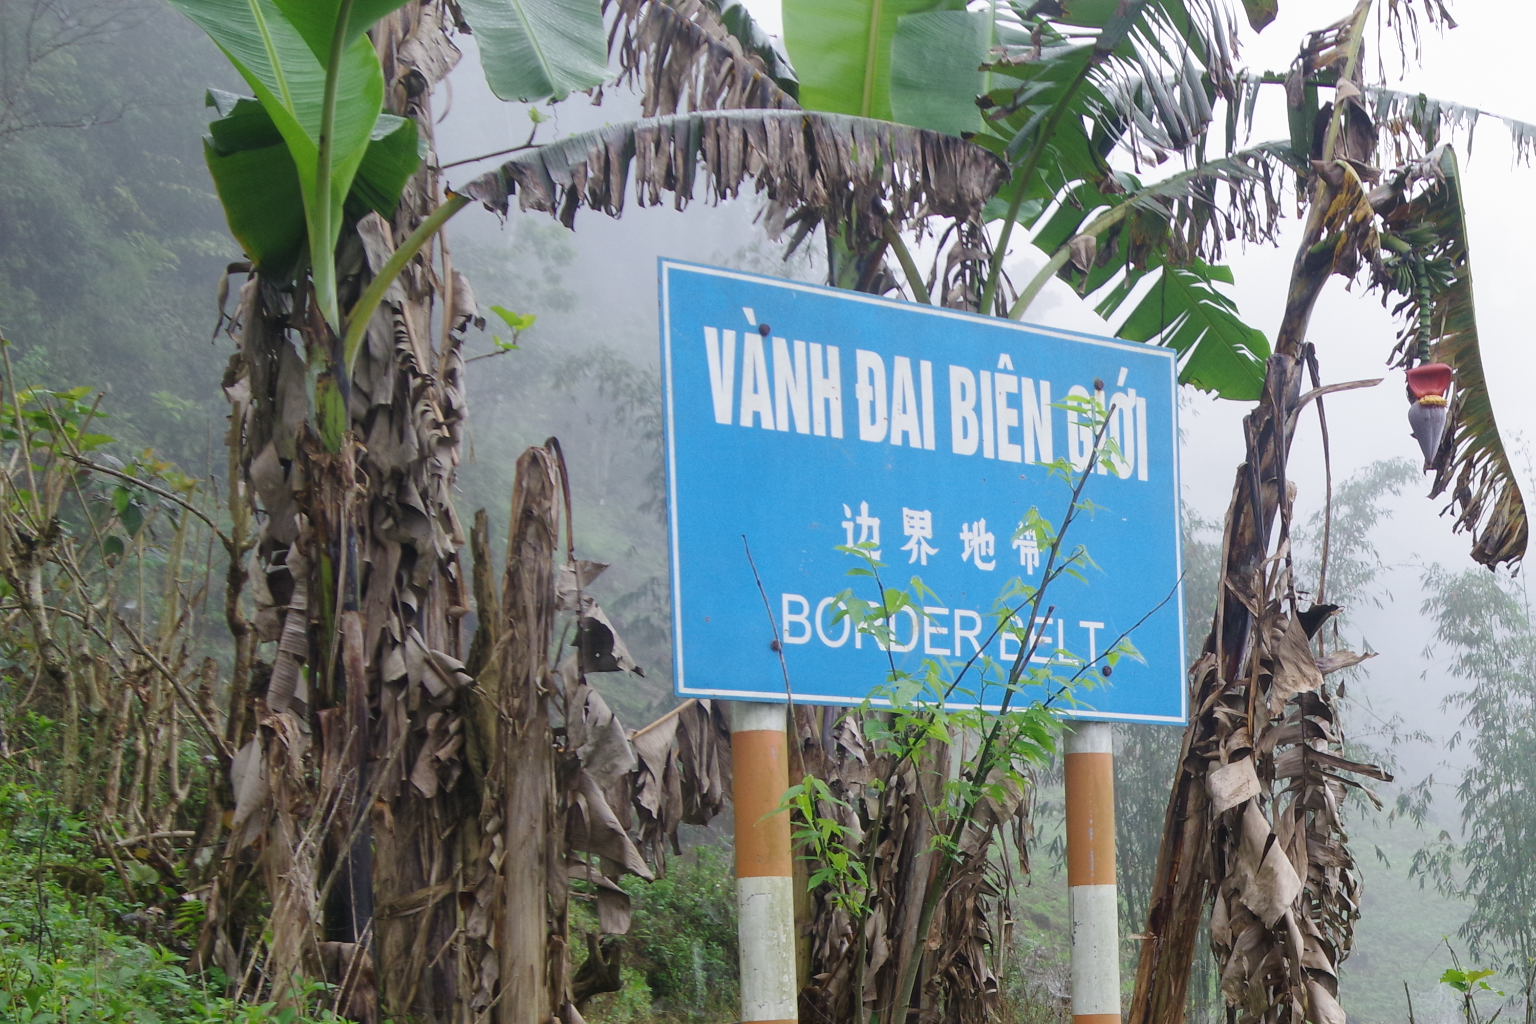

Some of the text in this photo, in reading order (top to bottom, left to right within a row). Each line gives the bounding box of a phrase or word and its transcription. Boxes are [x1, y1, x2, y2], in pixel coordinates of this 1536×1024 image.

[704, 307, 1149, 482] VÀNH ĐAI BIÊN GIỚI
[1000, 614, 1105, 668] BELT
